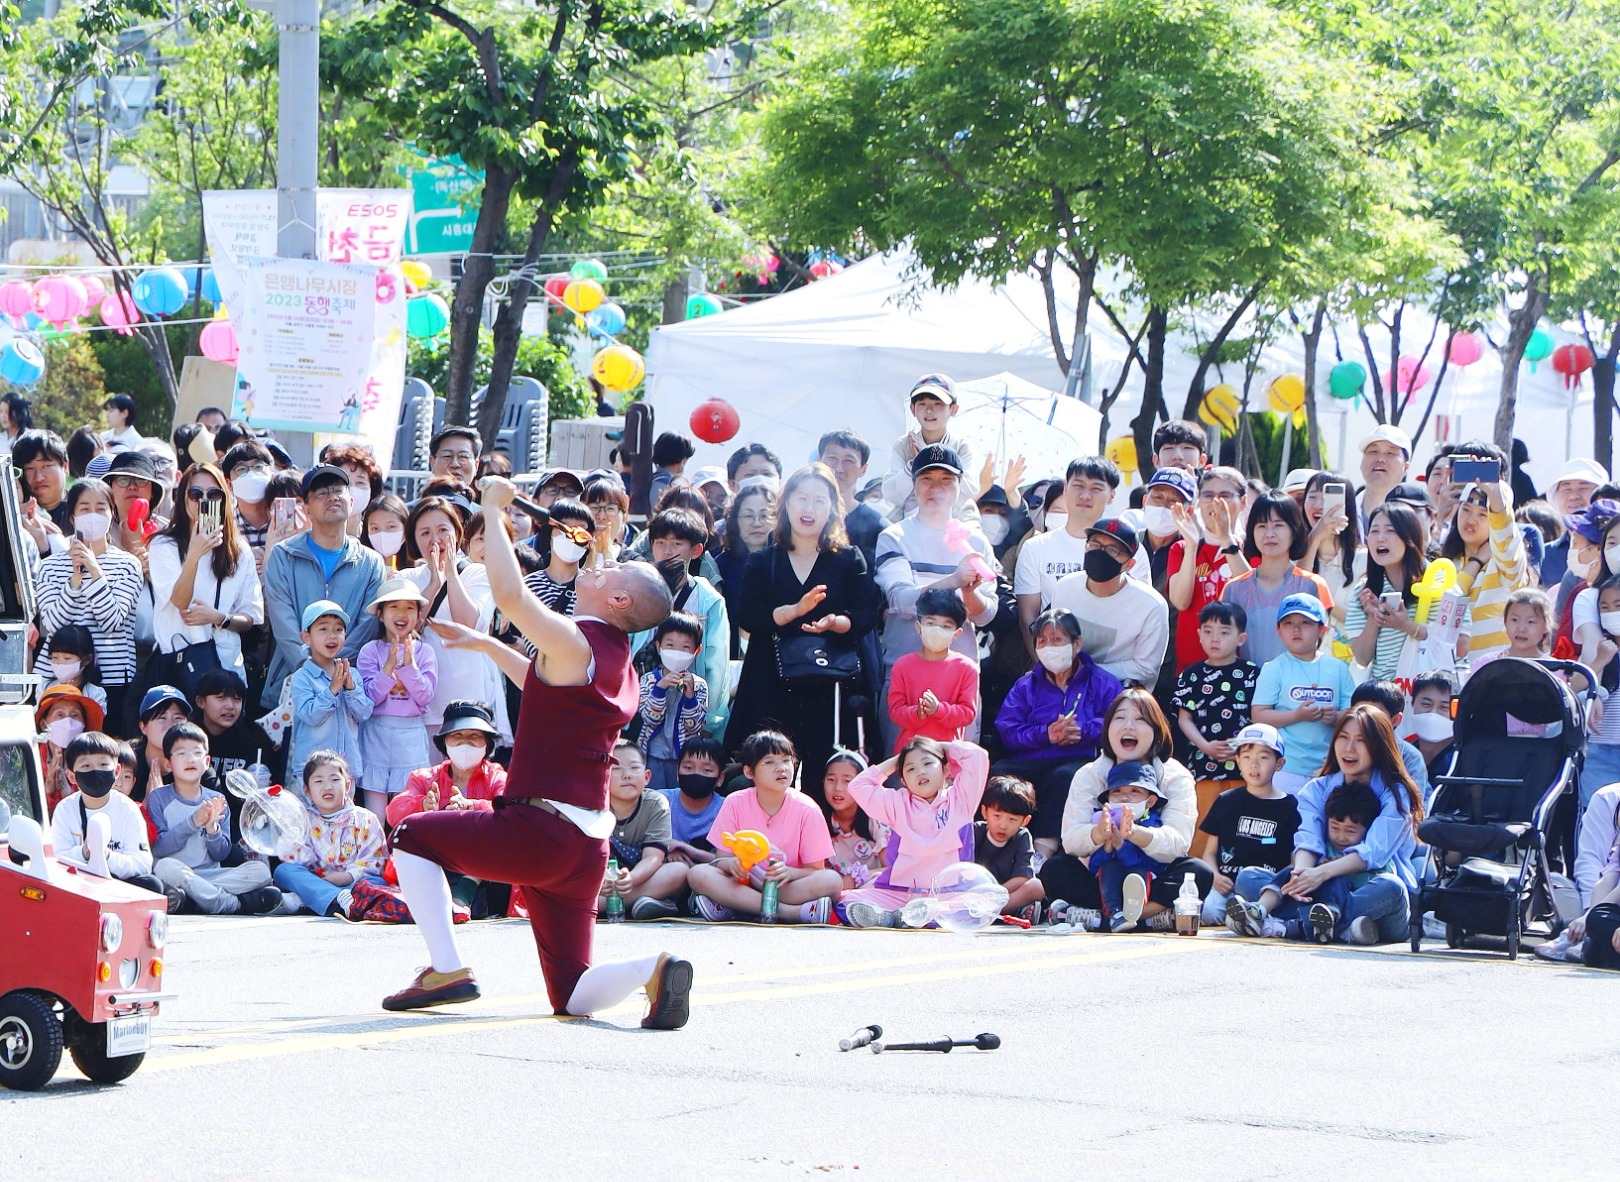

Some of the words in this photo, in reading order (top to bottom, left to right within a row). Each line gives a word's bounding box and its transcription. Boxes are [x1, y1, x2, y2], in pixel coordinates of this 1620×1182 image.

[442, 222, 477, 236] 시흥대
[265, 273, 358, 296] 은행나무시장
[265, 293, 302, 307] 2023
[1292, 688, 1333, 700] OUTDOOR
[1238, 818, 1251, 834] LOS
[1249, 820, 1275, 838] ANGELES
